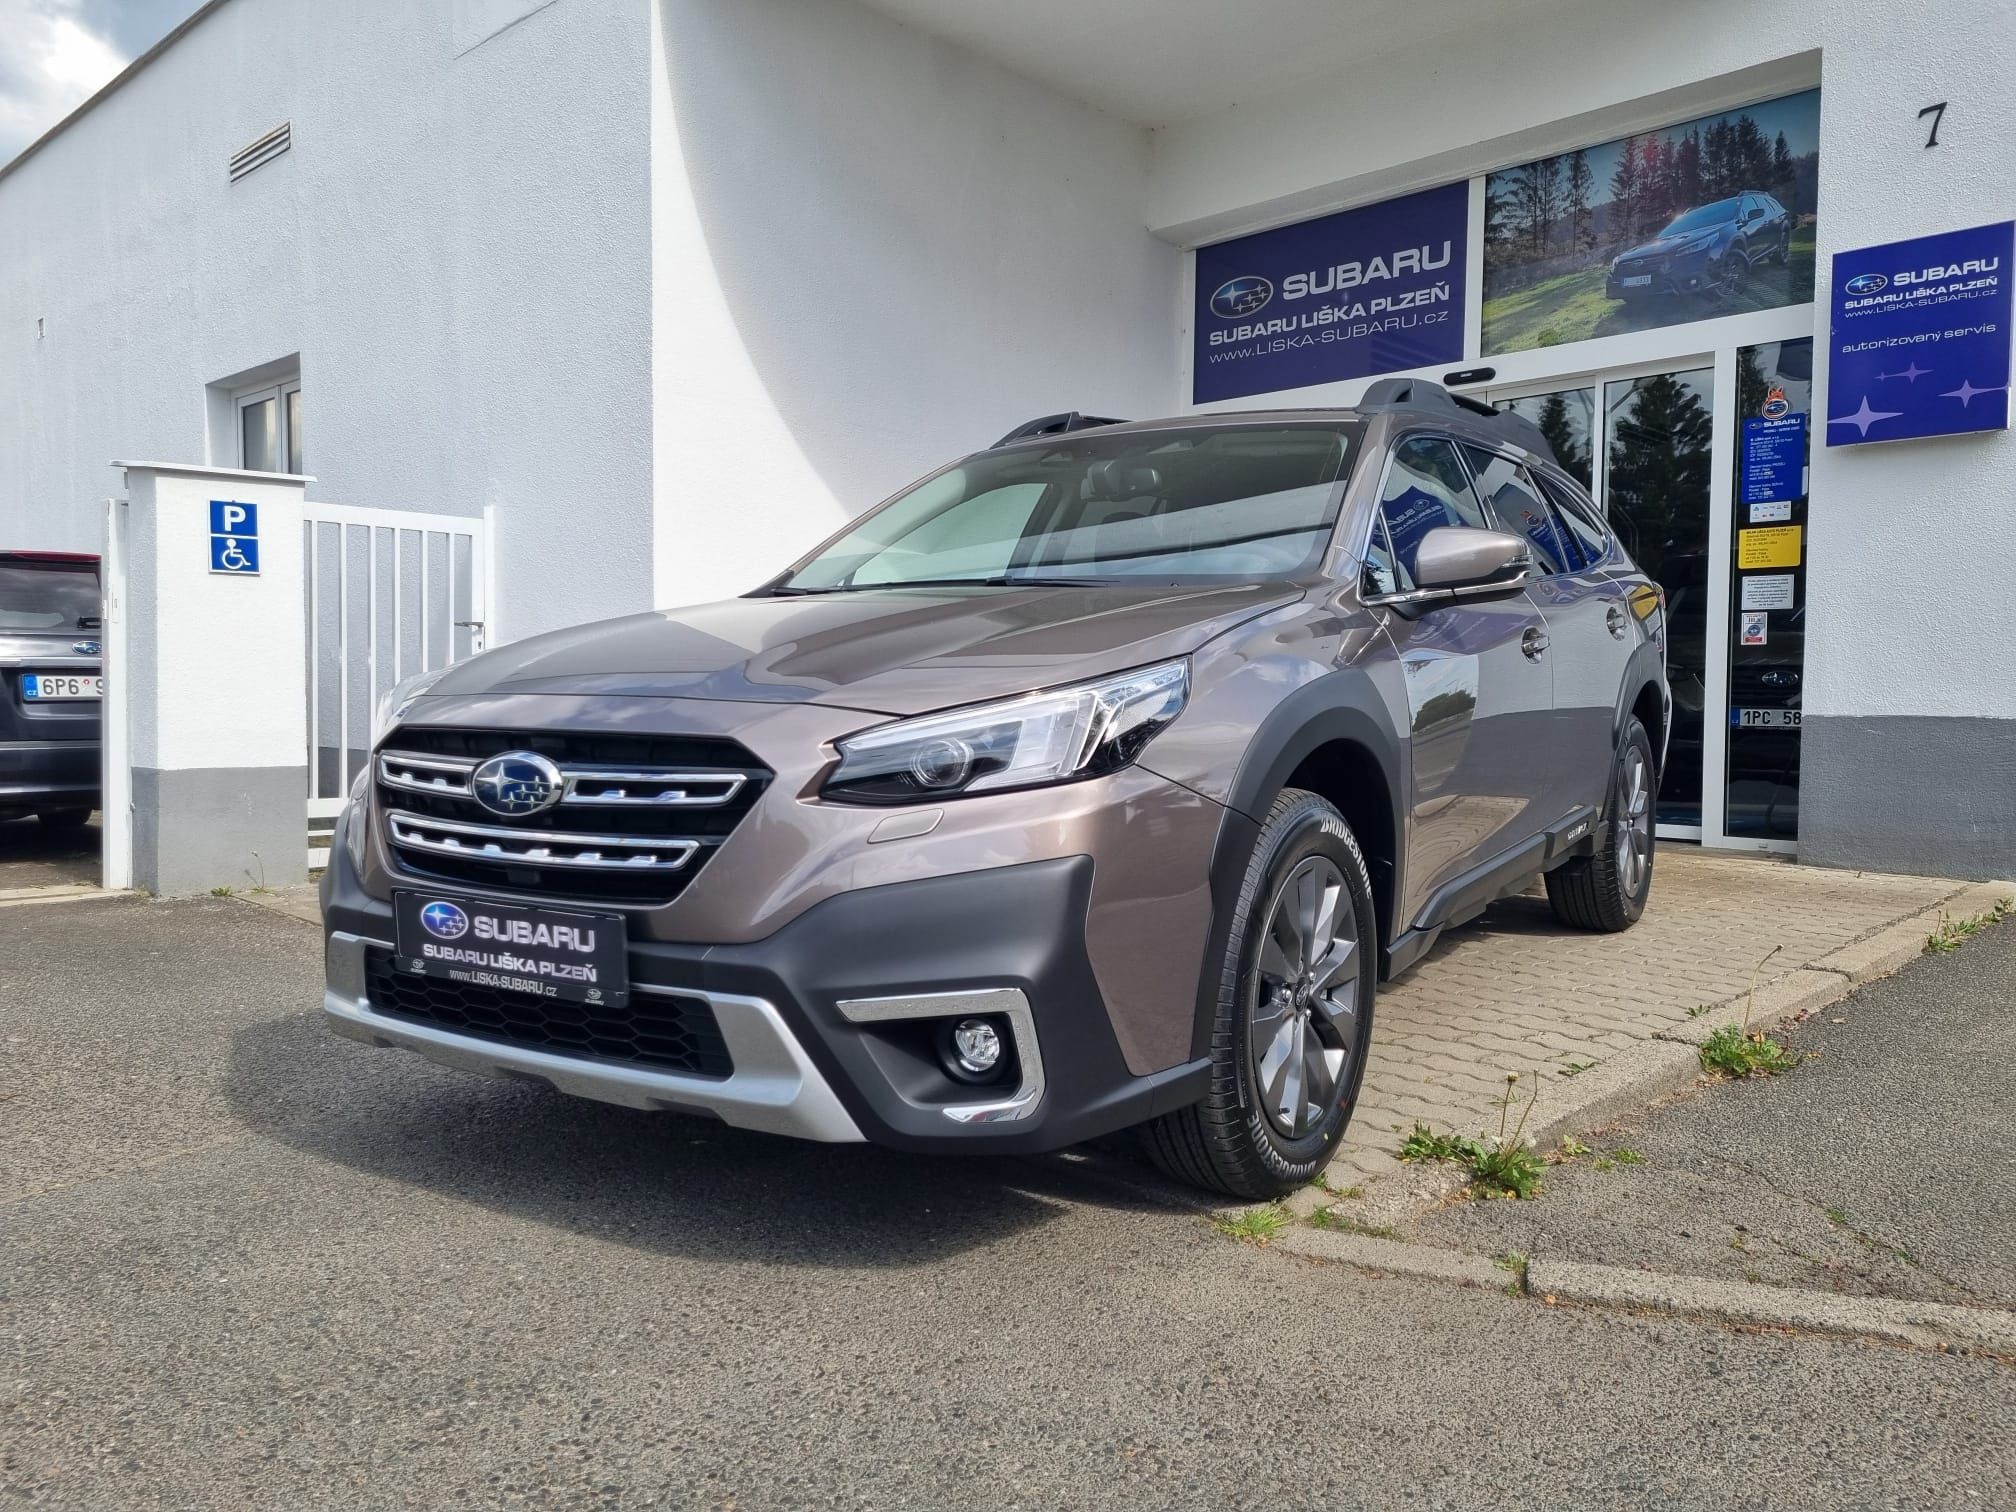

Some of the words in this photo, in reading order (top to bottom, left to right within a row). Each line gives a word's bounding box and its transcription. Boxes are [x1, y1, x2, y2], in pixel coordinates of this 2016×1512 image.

[1917, 101, 1947, 149] 7
[1282, 241, 1451, 300] SUBARU
[1893, 256, 1999, 286] SUBARU
[1845, 293, 1903, 309] SUBARU
[1905, 285, 1947, 299] LIŠKA
[1949, 275, 1998, 294] PLZEŇ
[1209, 316, 1297, 346] SUBARU
[1301, 305, 1366, 329] LIŠKA
[1370, 280, 1450, 315] PLZEŇ
[1209, 310, 1449, 364] www.LISKA-SUBARU.cz
[1842, 331, 1942, 353] autorizovaný
[1944, 323, 1996, 338] servis
[1763, 418, 1800, 427] SUBARU
[223, 505, 246, 532] P
[42, 678, 80, 695] 6P6
[1744, 710, 1771, 724] 1PC
[1783, 711, 1802, 725] 58
[1320, 814, 1373, 899] BRIDGESTONE
[474, 915, 596, 953] SUBARU
[423, 943, 488, 966] SUBARU
[489, 952, 537, 974] LIŠKA
[539, 961, 598, 983] PLZEŇ
[449, 969, 558, 998] www.LISKA-SUBARU.cz
